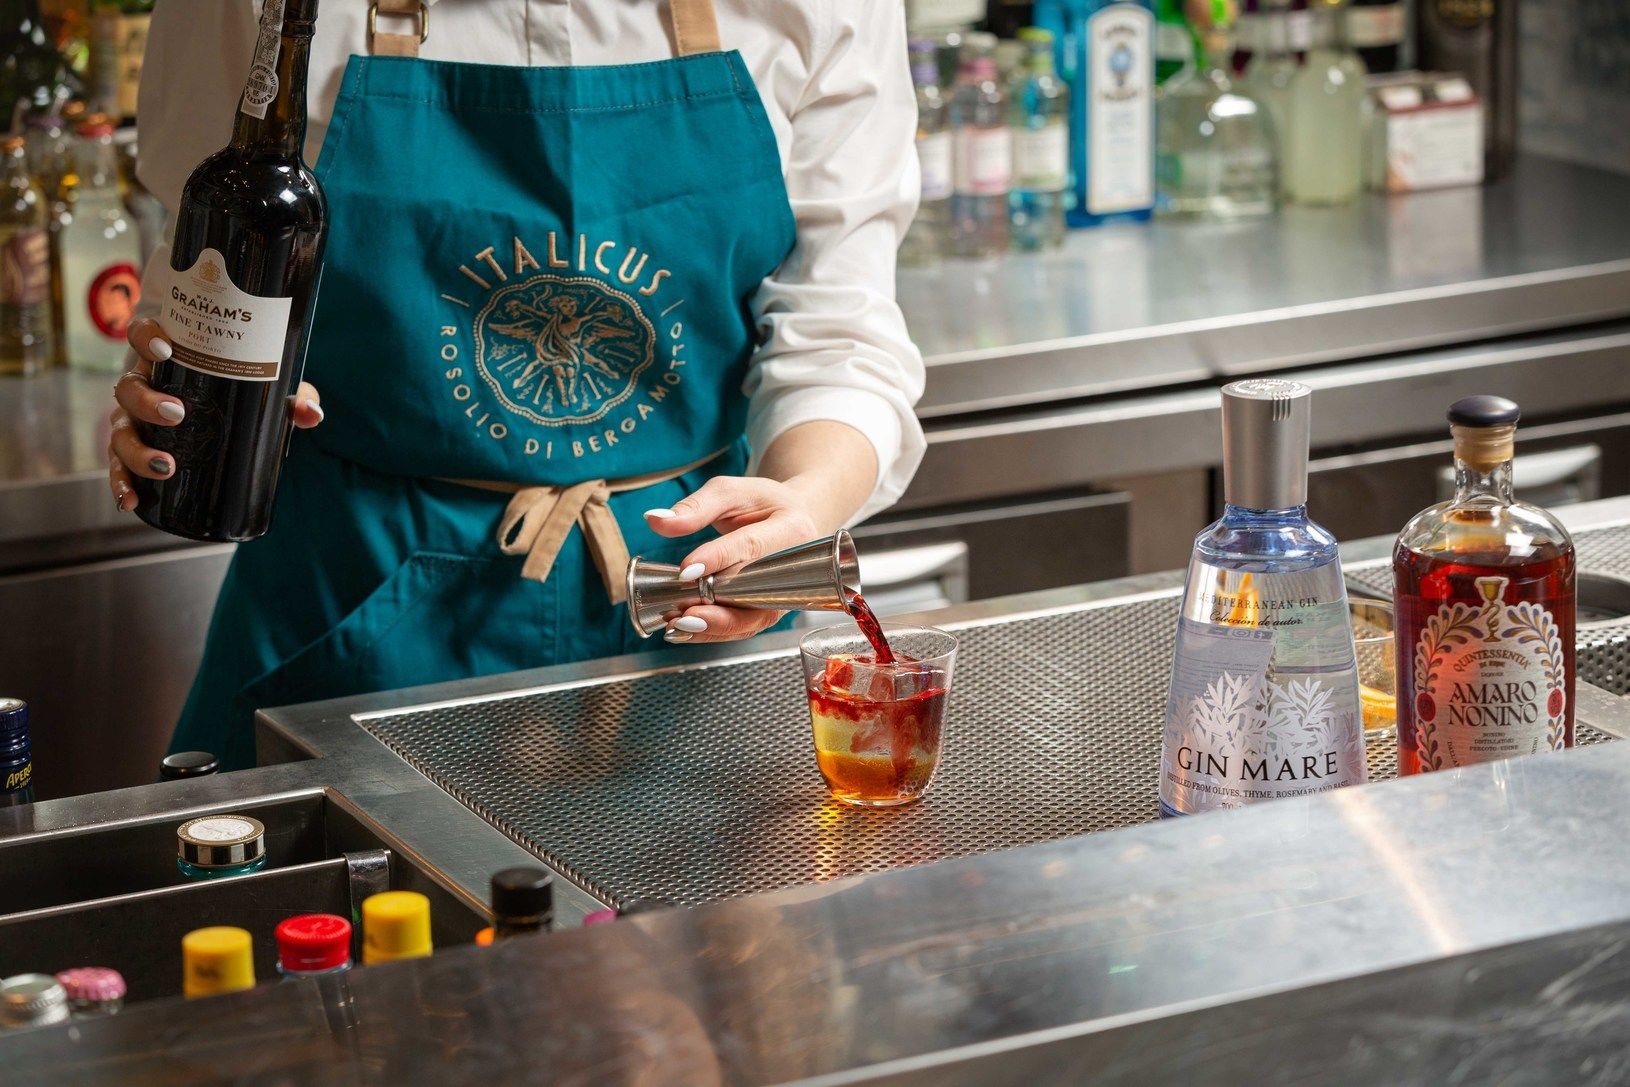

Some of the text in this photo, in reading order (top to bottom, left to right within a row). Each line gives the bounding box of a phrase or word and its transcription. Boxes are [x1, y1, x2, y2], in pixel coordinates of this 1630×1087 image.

[458, 231, 671, 296] ITALICUS
[171, 286, 252, 322] GRAHAM'S
[170, 308, 245, 341] FINE TAWNY
[188, 331, 211, 344] PORT
[440, 325, 507, 439] ROSOLIO
[523, 437, 553, 459] DI
[1299, 596, 1318, 608] GIN
[1209, 610, 1255, 626] Colección
[1257, 614, 1270, 626] de
[1449, 680, 1537, 704] AMARO
[1448, 702, 1539, 727] NONINO
[6, 762, 32, 788] APERO
[1177, 746, 1338, 782] GIN MARE
[1167, 770, 1192, 788] DISTILLED
[1192, 781, 1212, 793] FROM
[1276, 788, 1316, 799] ROSEMARY
[1318, 784, 1332, 793] AND
